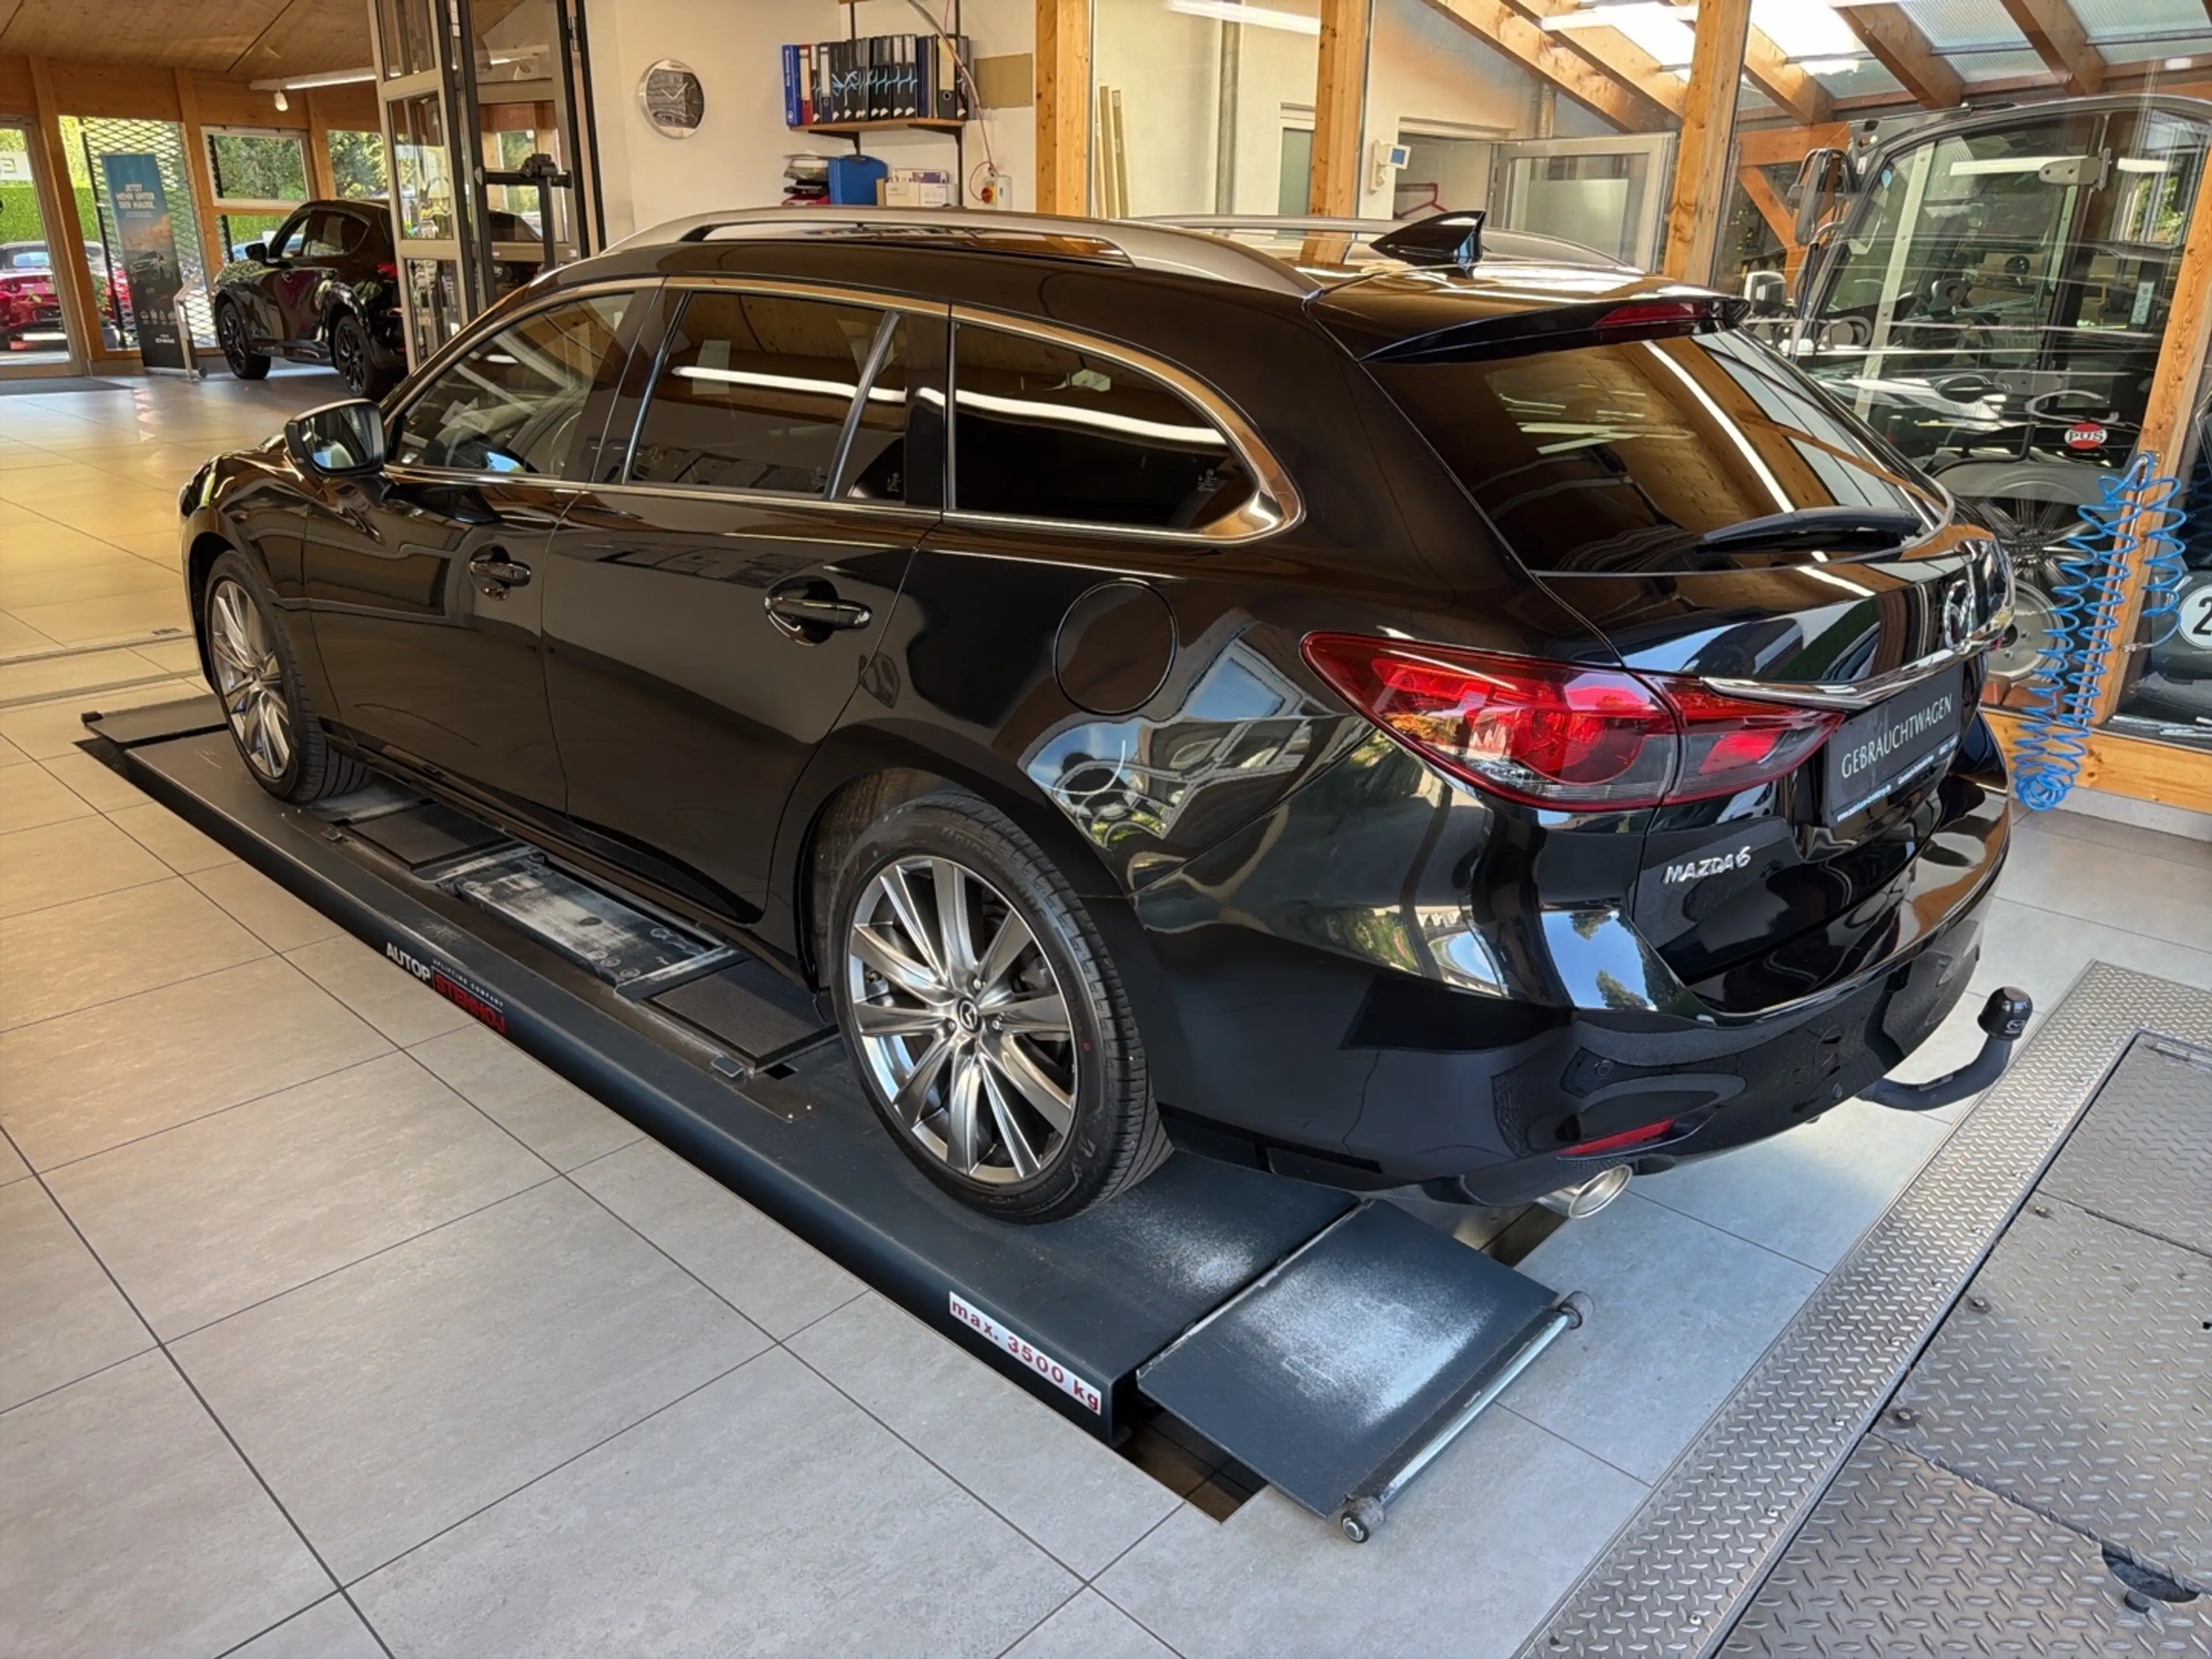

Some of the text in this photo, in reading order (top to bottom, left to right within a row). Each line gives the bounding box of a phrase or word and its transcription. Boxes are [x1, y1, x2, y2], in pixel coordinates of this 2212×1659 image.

[1841, 693, 1952, 779] GEBRAUCHTWAGEN
[387, 942, 431, 981] AUTOP
[952, 1301, 1099, 1411] max. 3500 kg
